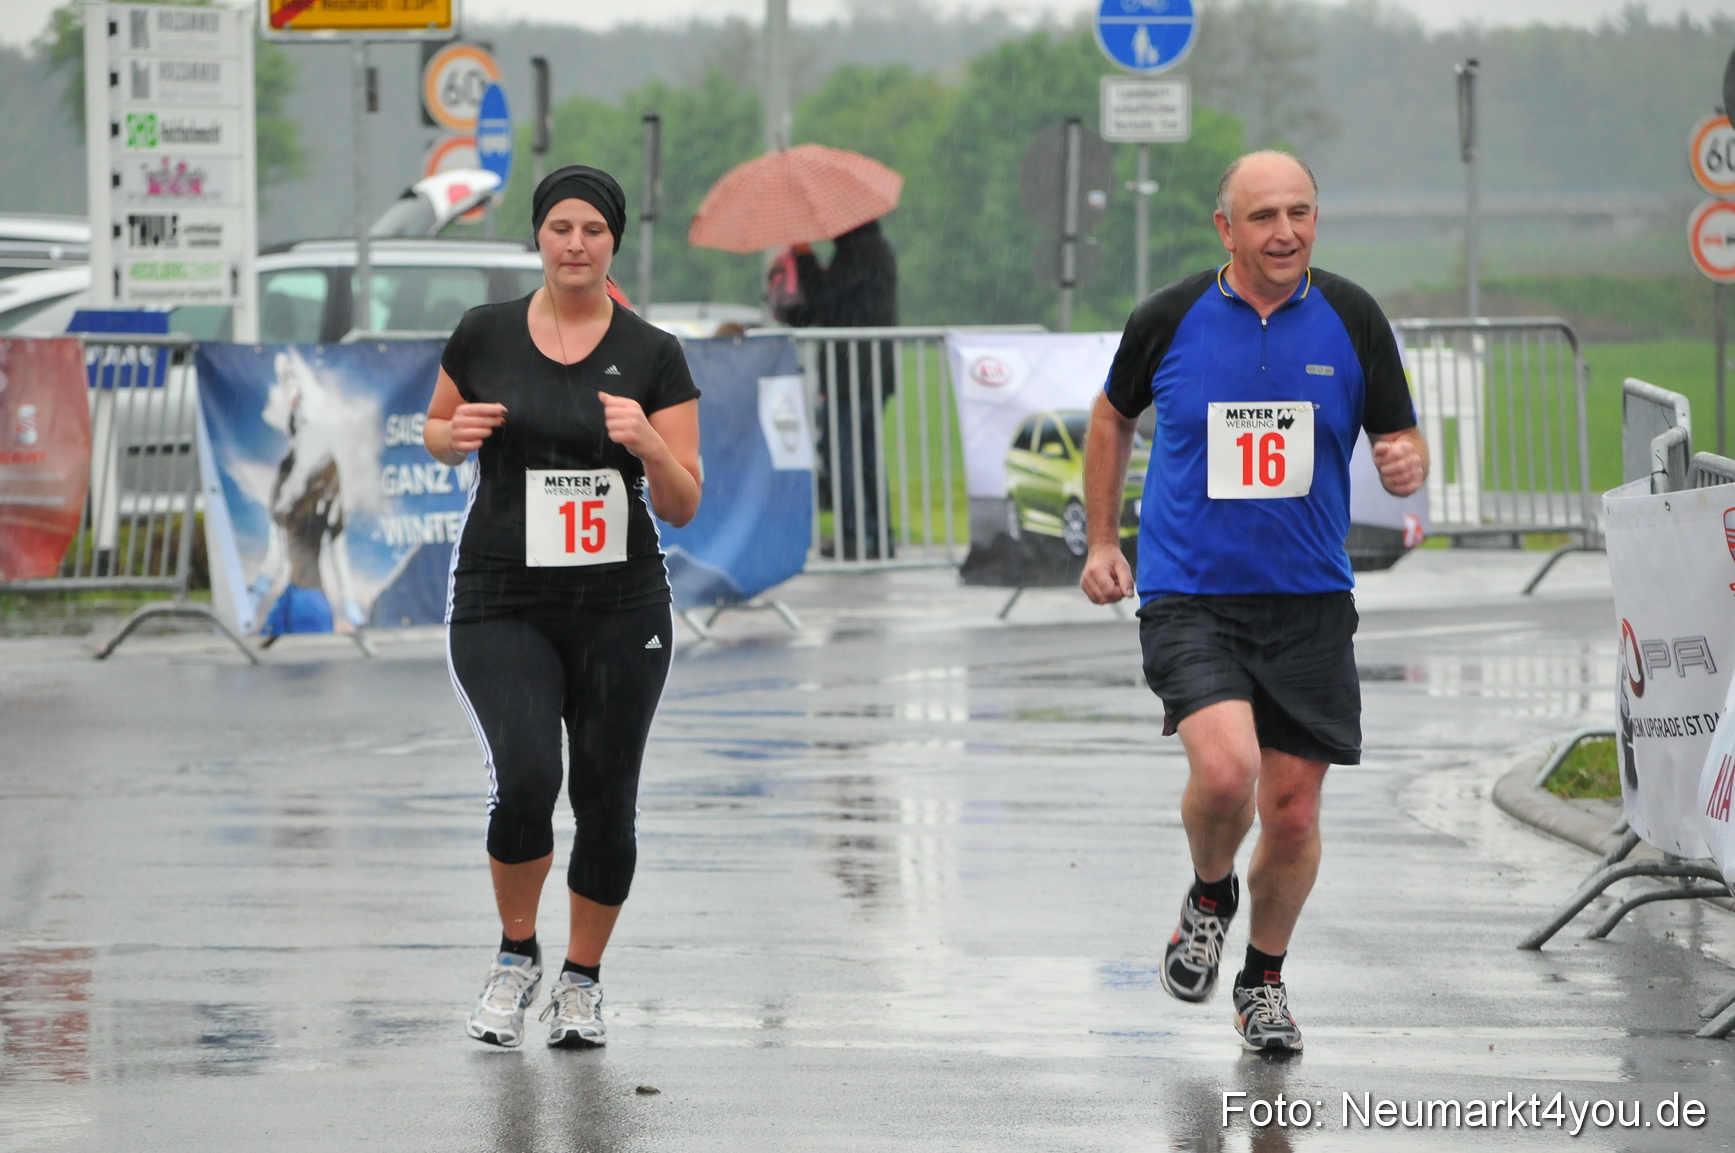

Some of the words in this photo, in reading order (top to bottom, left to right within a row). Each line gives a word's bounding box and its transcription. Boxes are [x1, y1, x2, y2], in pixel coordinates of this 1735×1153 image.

[443, 70, 482, 106] 60
[1225, 420, 1274, 428] WERBUNG
[1226, 409, 1273, 419] MEYER
[1236, 432, 1285, 487] 16
[382, 463, 453, 496] GANZ
[545, 476, 592, 486] MEYER
[544, 487, 592, 496] WERBUNG
[559, 501, 606, 553] 15
[1644, 717, 1683, 738] UPGRADE
[1682, 715, 1703, 736] IST
